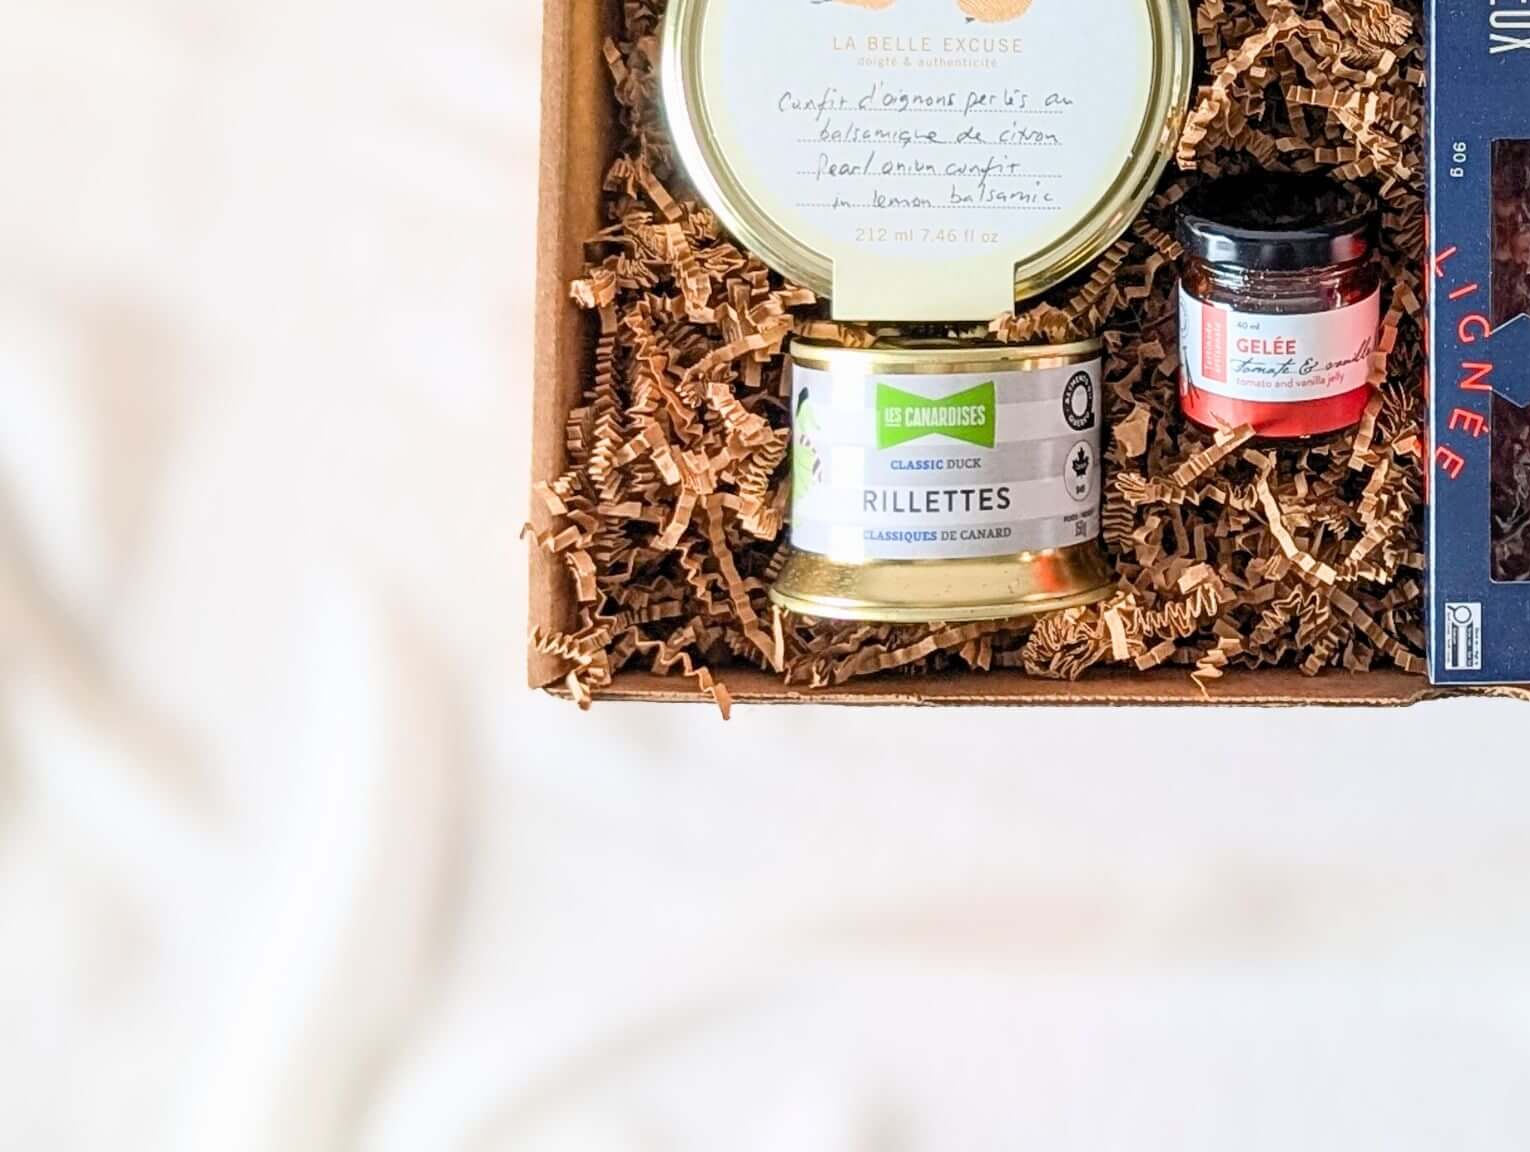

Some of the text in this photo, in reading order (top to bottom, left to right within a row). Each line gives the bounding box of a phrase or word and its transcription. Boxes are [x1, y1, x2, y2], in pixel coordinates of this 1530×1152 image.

[833, 36, 1023, 54] LA BELLE EXCUSE
[857, 55, 997, 69] doigté & authenticité
[1045, 90, 1073, 106] au
[956, 126, 987, 144] de
[1000, 121, 1059, 144] citron
[1450, 142, 1466, 177] 90 g
[873, 190, 932, 209] lemon
[950, 181, 1054, 204] balsamic
[856, 228, 998, 244] 212 ml 7.46 fl oz
[1236, 336, 1297, 355] GELÉE
[1230, 357, 1295, 378] tomate
[1236, 371, 1345, 389] tomato and vanilla jelly
[884, 404, 986, 427] LES CANARDISES
[890, 457, 982, 471] CLASSIC DUCK
[863, 486, 1010, 513] RILLETTES
[864, 527, 1012, 543] CLASSIQUES DE CANARD
